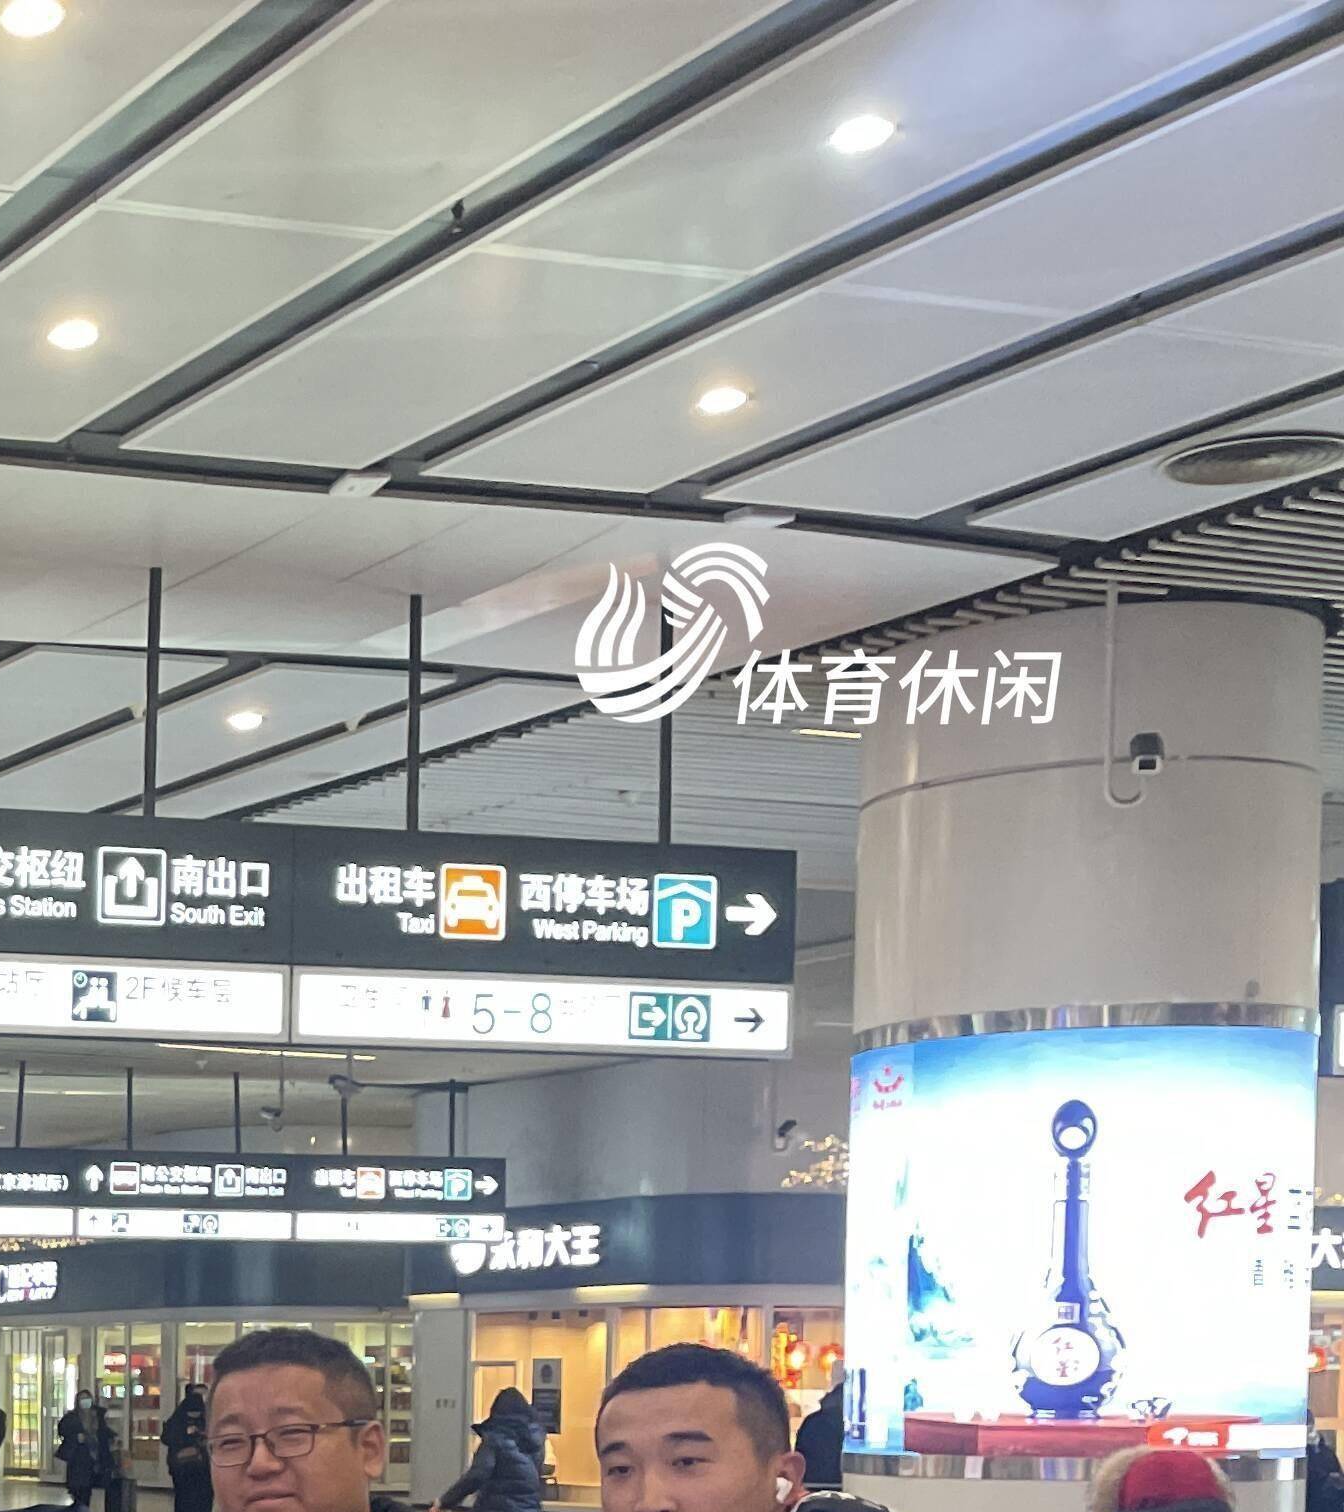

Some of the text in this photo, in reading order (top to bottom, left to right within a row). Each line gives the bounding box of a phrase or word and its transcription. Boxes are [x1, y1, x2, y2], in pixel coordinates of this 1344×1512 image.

[170, 854, 269, 898] 南出口
[335, 862, 436, 906] 出租车
[10, 896, 76, 919] Station
[519, 873, 650, 917] 西停车场
[170, 902, 266, 927] South Exit
[397, 912, 435, 935] Taxi
[533, 918, 649, 947] West Parking
[1184, 1170, 1276, 1239] 红星
